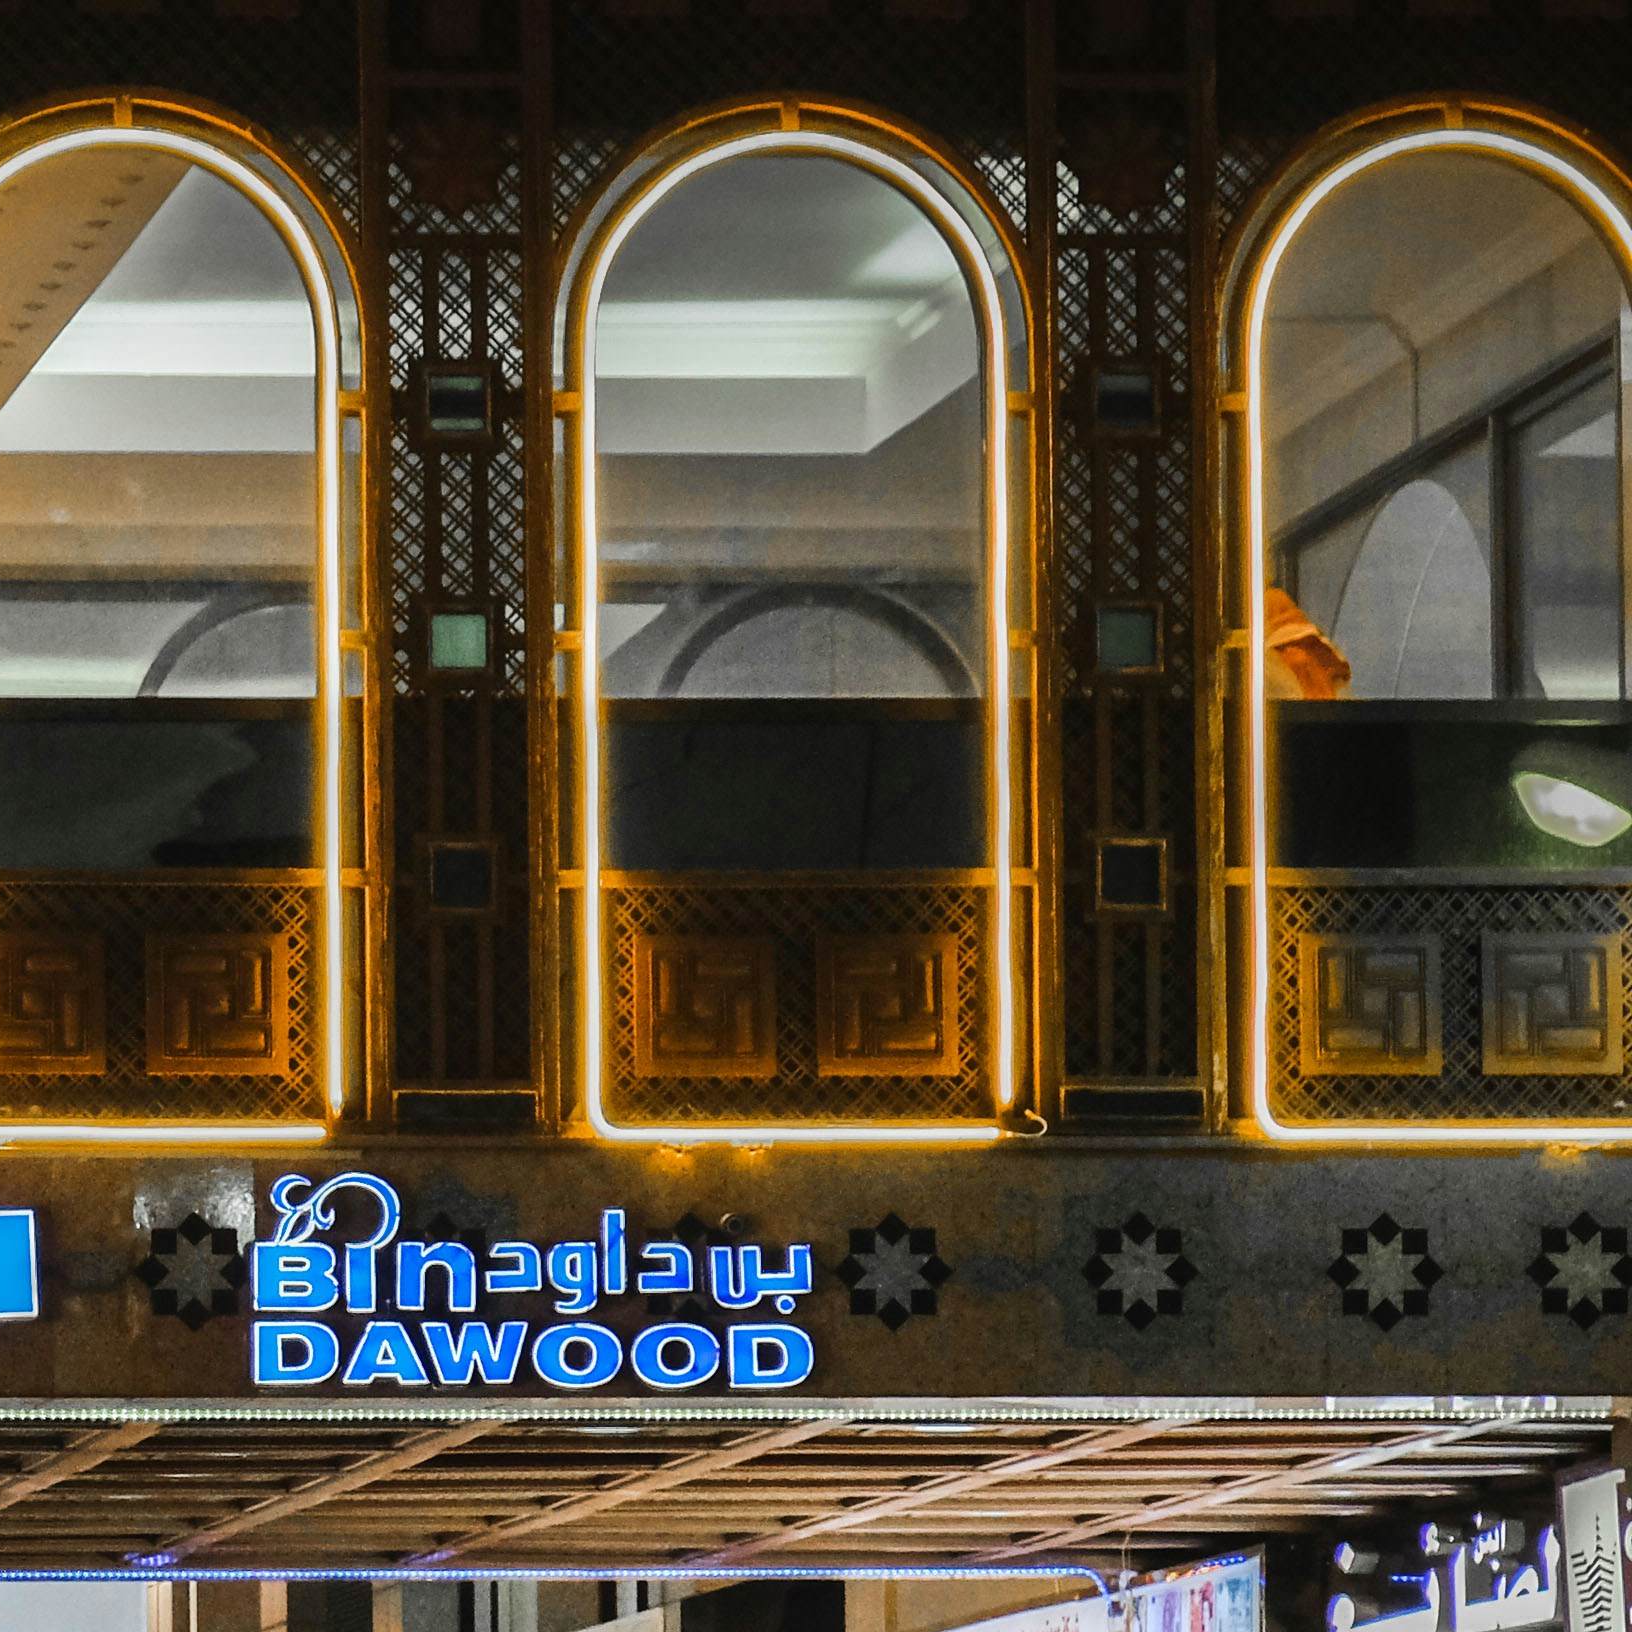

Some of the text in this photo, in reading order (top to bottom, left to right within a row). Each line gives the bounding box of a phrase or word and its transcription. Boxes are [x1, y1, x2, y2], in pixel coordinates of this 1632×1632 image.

[252, 1172, 477, 1313] Bin
[485, 1208, 696, 1314] داود
[253, 1321, 815, 1390] DAWOOD
